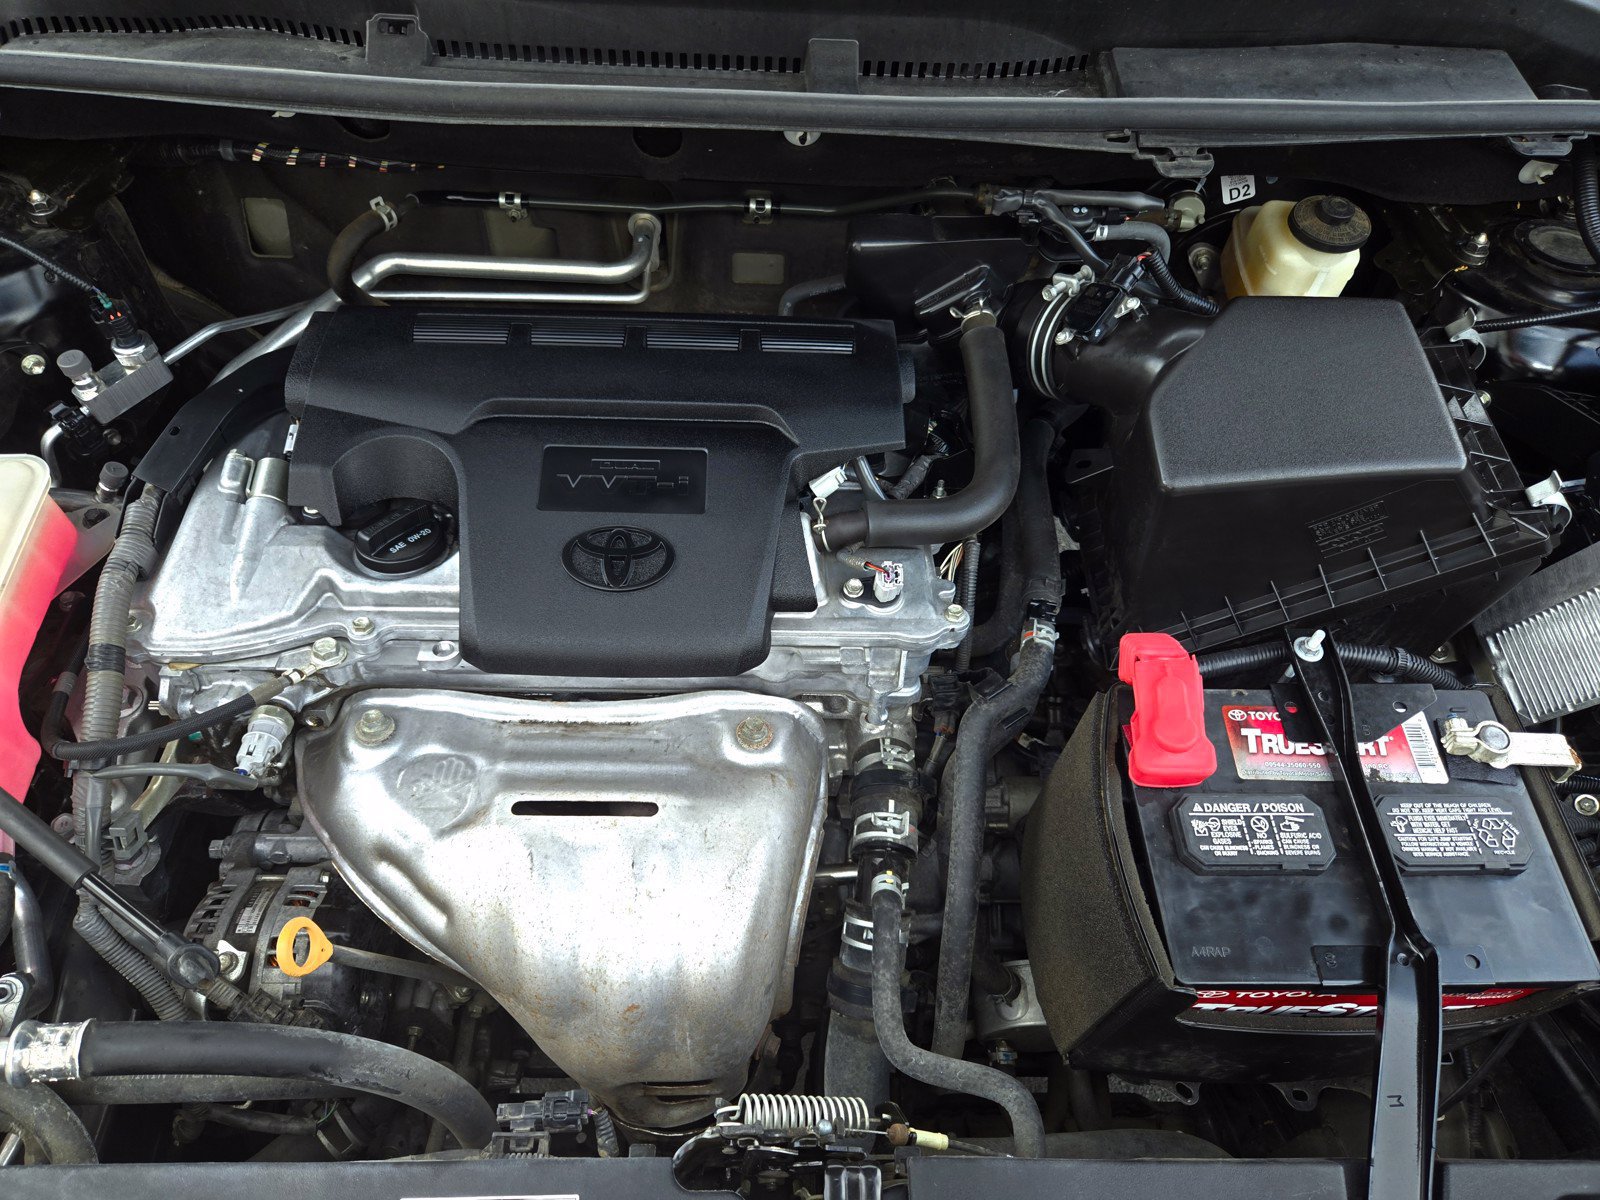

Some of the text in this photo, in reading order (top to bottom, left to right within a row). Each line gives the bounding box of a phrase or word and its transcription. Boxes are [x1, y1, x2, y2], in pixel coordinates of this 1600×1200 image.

[1229, 183, 1251, 200] D2
[389, 528, 432, 554] SAE 0W-20
[1247, 711, 1281, 721] TOYO
[1203, 803, 1304, 812] DANGER / POISON
[1221, 818, 1242, 826] SHIELD
[1212, 837, 1232, 845] GASES
